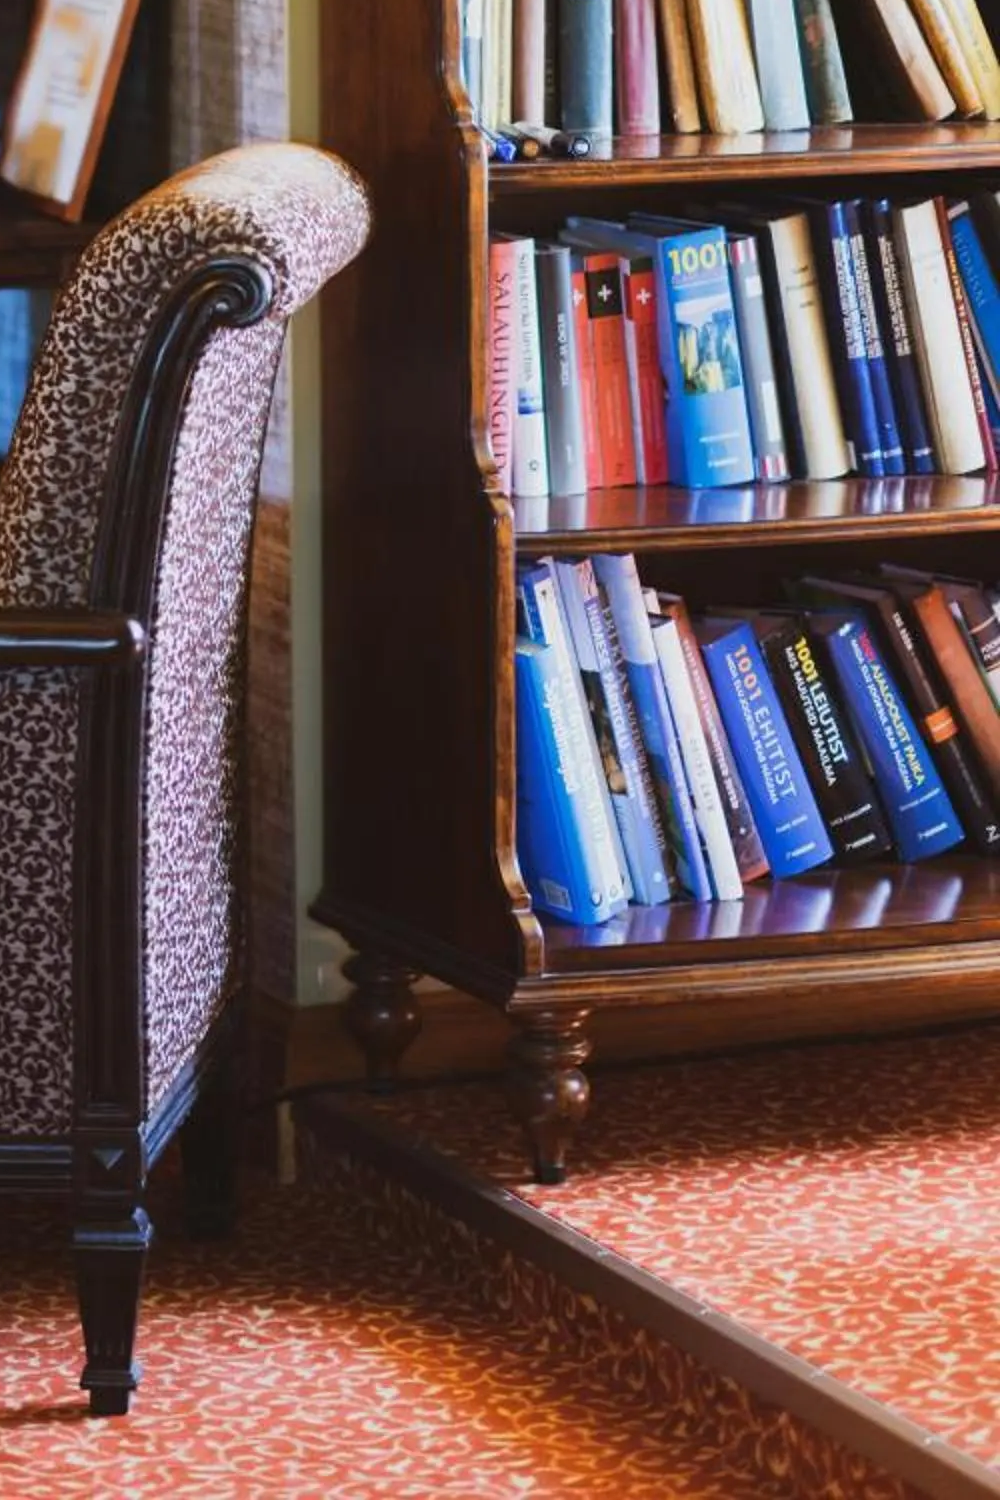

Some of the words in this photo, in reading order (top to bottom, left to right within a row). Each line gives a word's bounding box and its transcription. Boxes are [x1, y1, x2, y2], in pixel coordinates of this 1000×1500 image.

[668, 241, 726, 275] 1001
[491, 273, 510, 469] SALAUHINGUD
[735, 644, 762, 701] 1001
[754, 705, 797, 797] EHITIST
[785, 645, 799, 670] MIS
[794, 670, 819, 727] MUUTSID
[812, 726, 837, 787] MAAILMA
[795, 636, 819, 682] 1001
[810, 680, 849, 763] LEIUTIST
[904, 743, 926, 788] PAIKA
